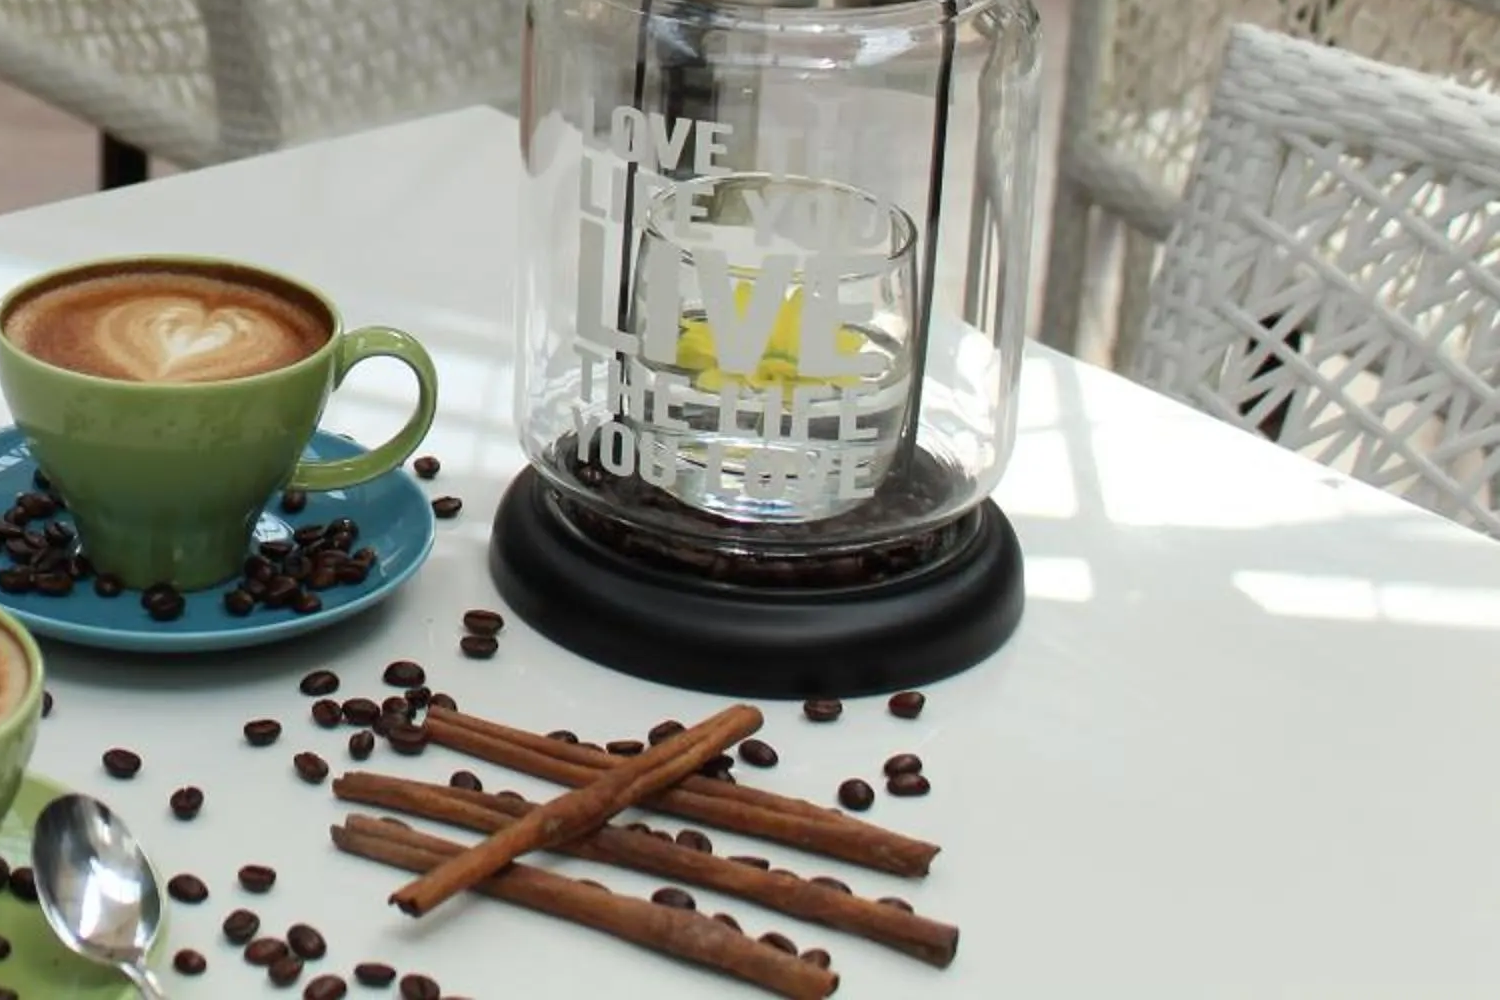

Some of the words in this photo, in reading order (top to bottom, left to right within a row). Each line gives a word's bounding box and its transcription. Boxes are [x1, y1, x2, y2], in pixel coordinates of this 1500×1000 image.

[581, 96, 733, 175] LOVE
[579, 155, 714, 239] LIFE
[742, 189, 888, 250] YOU
[576, 217, 892, 378] LIVE
[574, 343, 690, 430] THE
[718, 379, 879, 441] LIFE
[572, 405, 677, 486] YOU
[704, 440, 876, 499] LOVE
